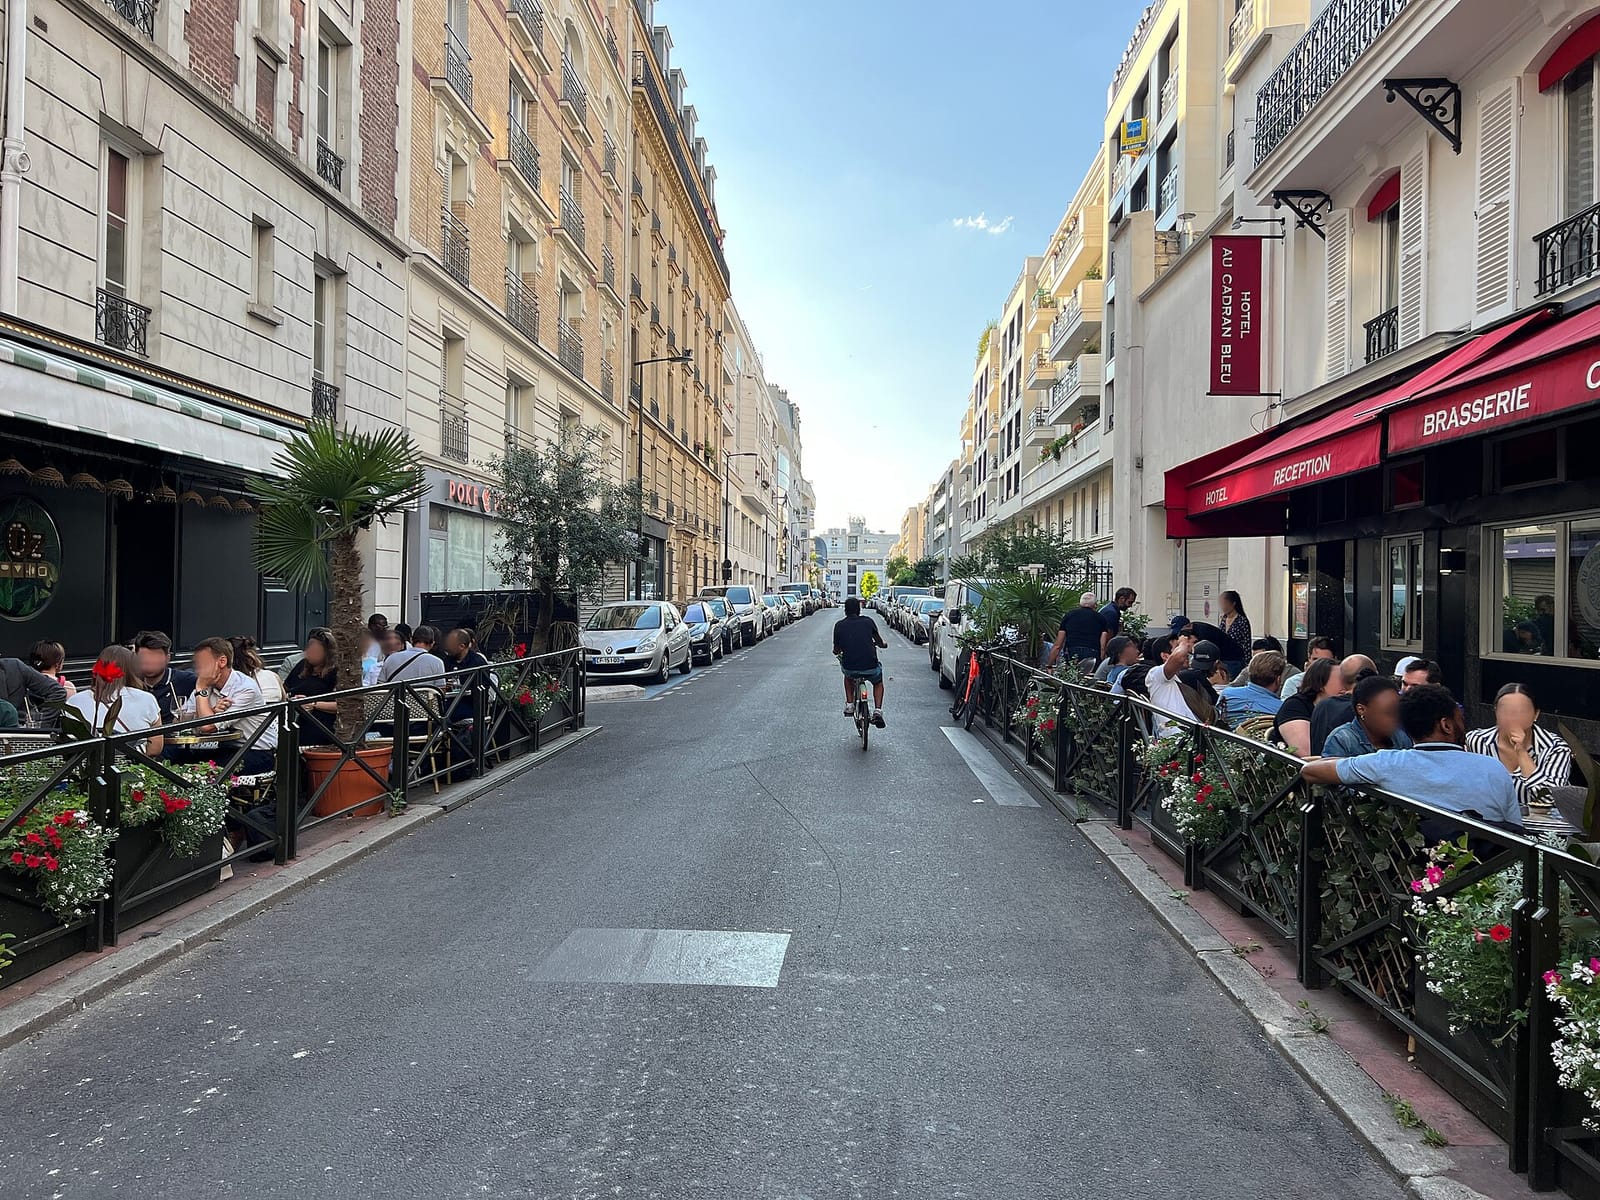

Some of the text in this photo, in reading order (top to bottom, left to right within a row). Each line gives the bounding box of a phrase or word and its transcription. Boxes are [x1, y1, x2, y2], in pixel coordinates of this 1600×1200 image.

[1220, 247, 1233, 384] AU CADRAN BLEU
[1240, 291, 1251, 339] HOTEL
[1422, 382, 1532, 436] BRASSERIE
[449, 480, 479, 506] POKE
[1205, 453, 1331, 506] HOTEL RECEPTION
